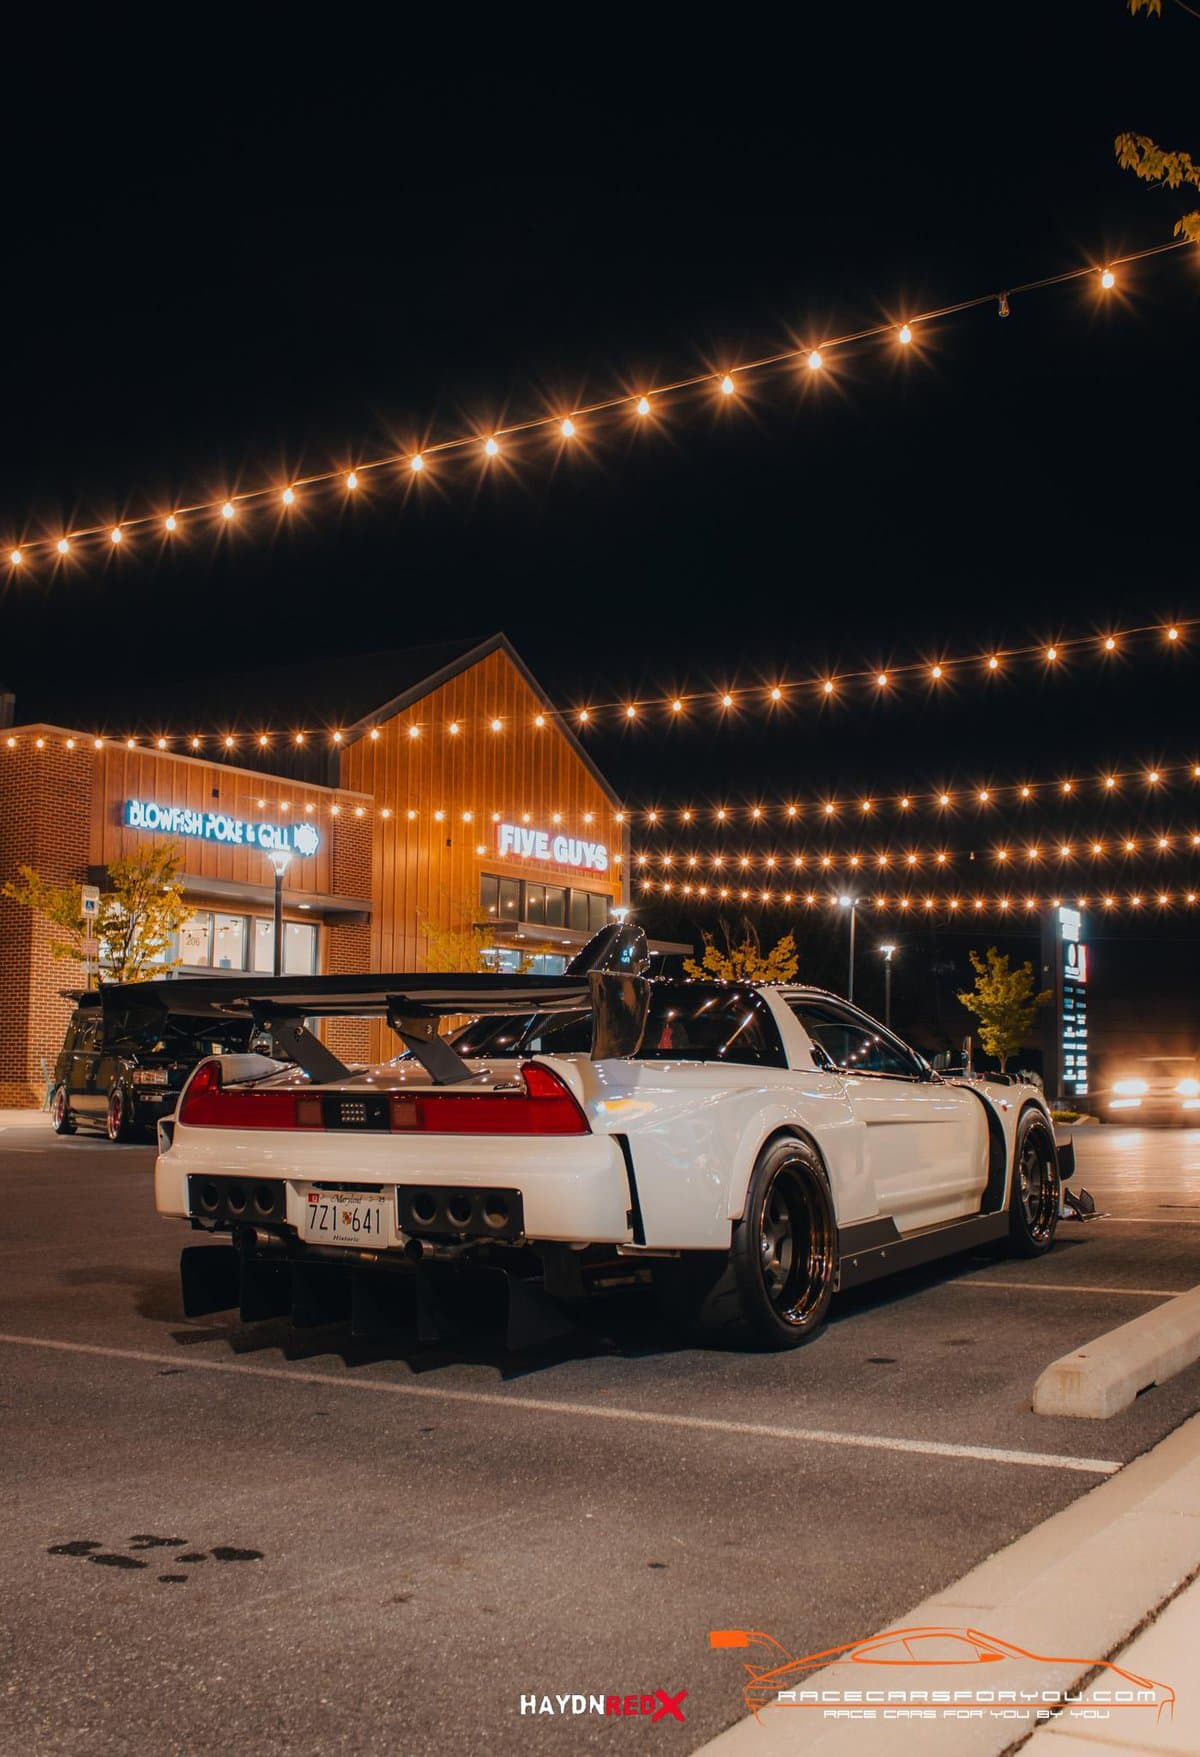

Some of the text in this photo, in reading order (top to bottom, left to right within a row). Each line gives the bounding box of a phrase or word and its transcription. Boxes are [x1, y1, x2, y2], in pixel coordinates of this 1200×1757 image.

[130, 801, 203, 836] BLOWFISH
[206, 813, 243, 843] POKE
[498, 824, 608, 871] FIVE GUYS
